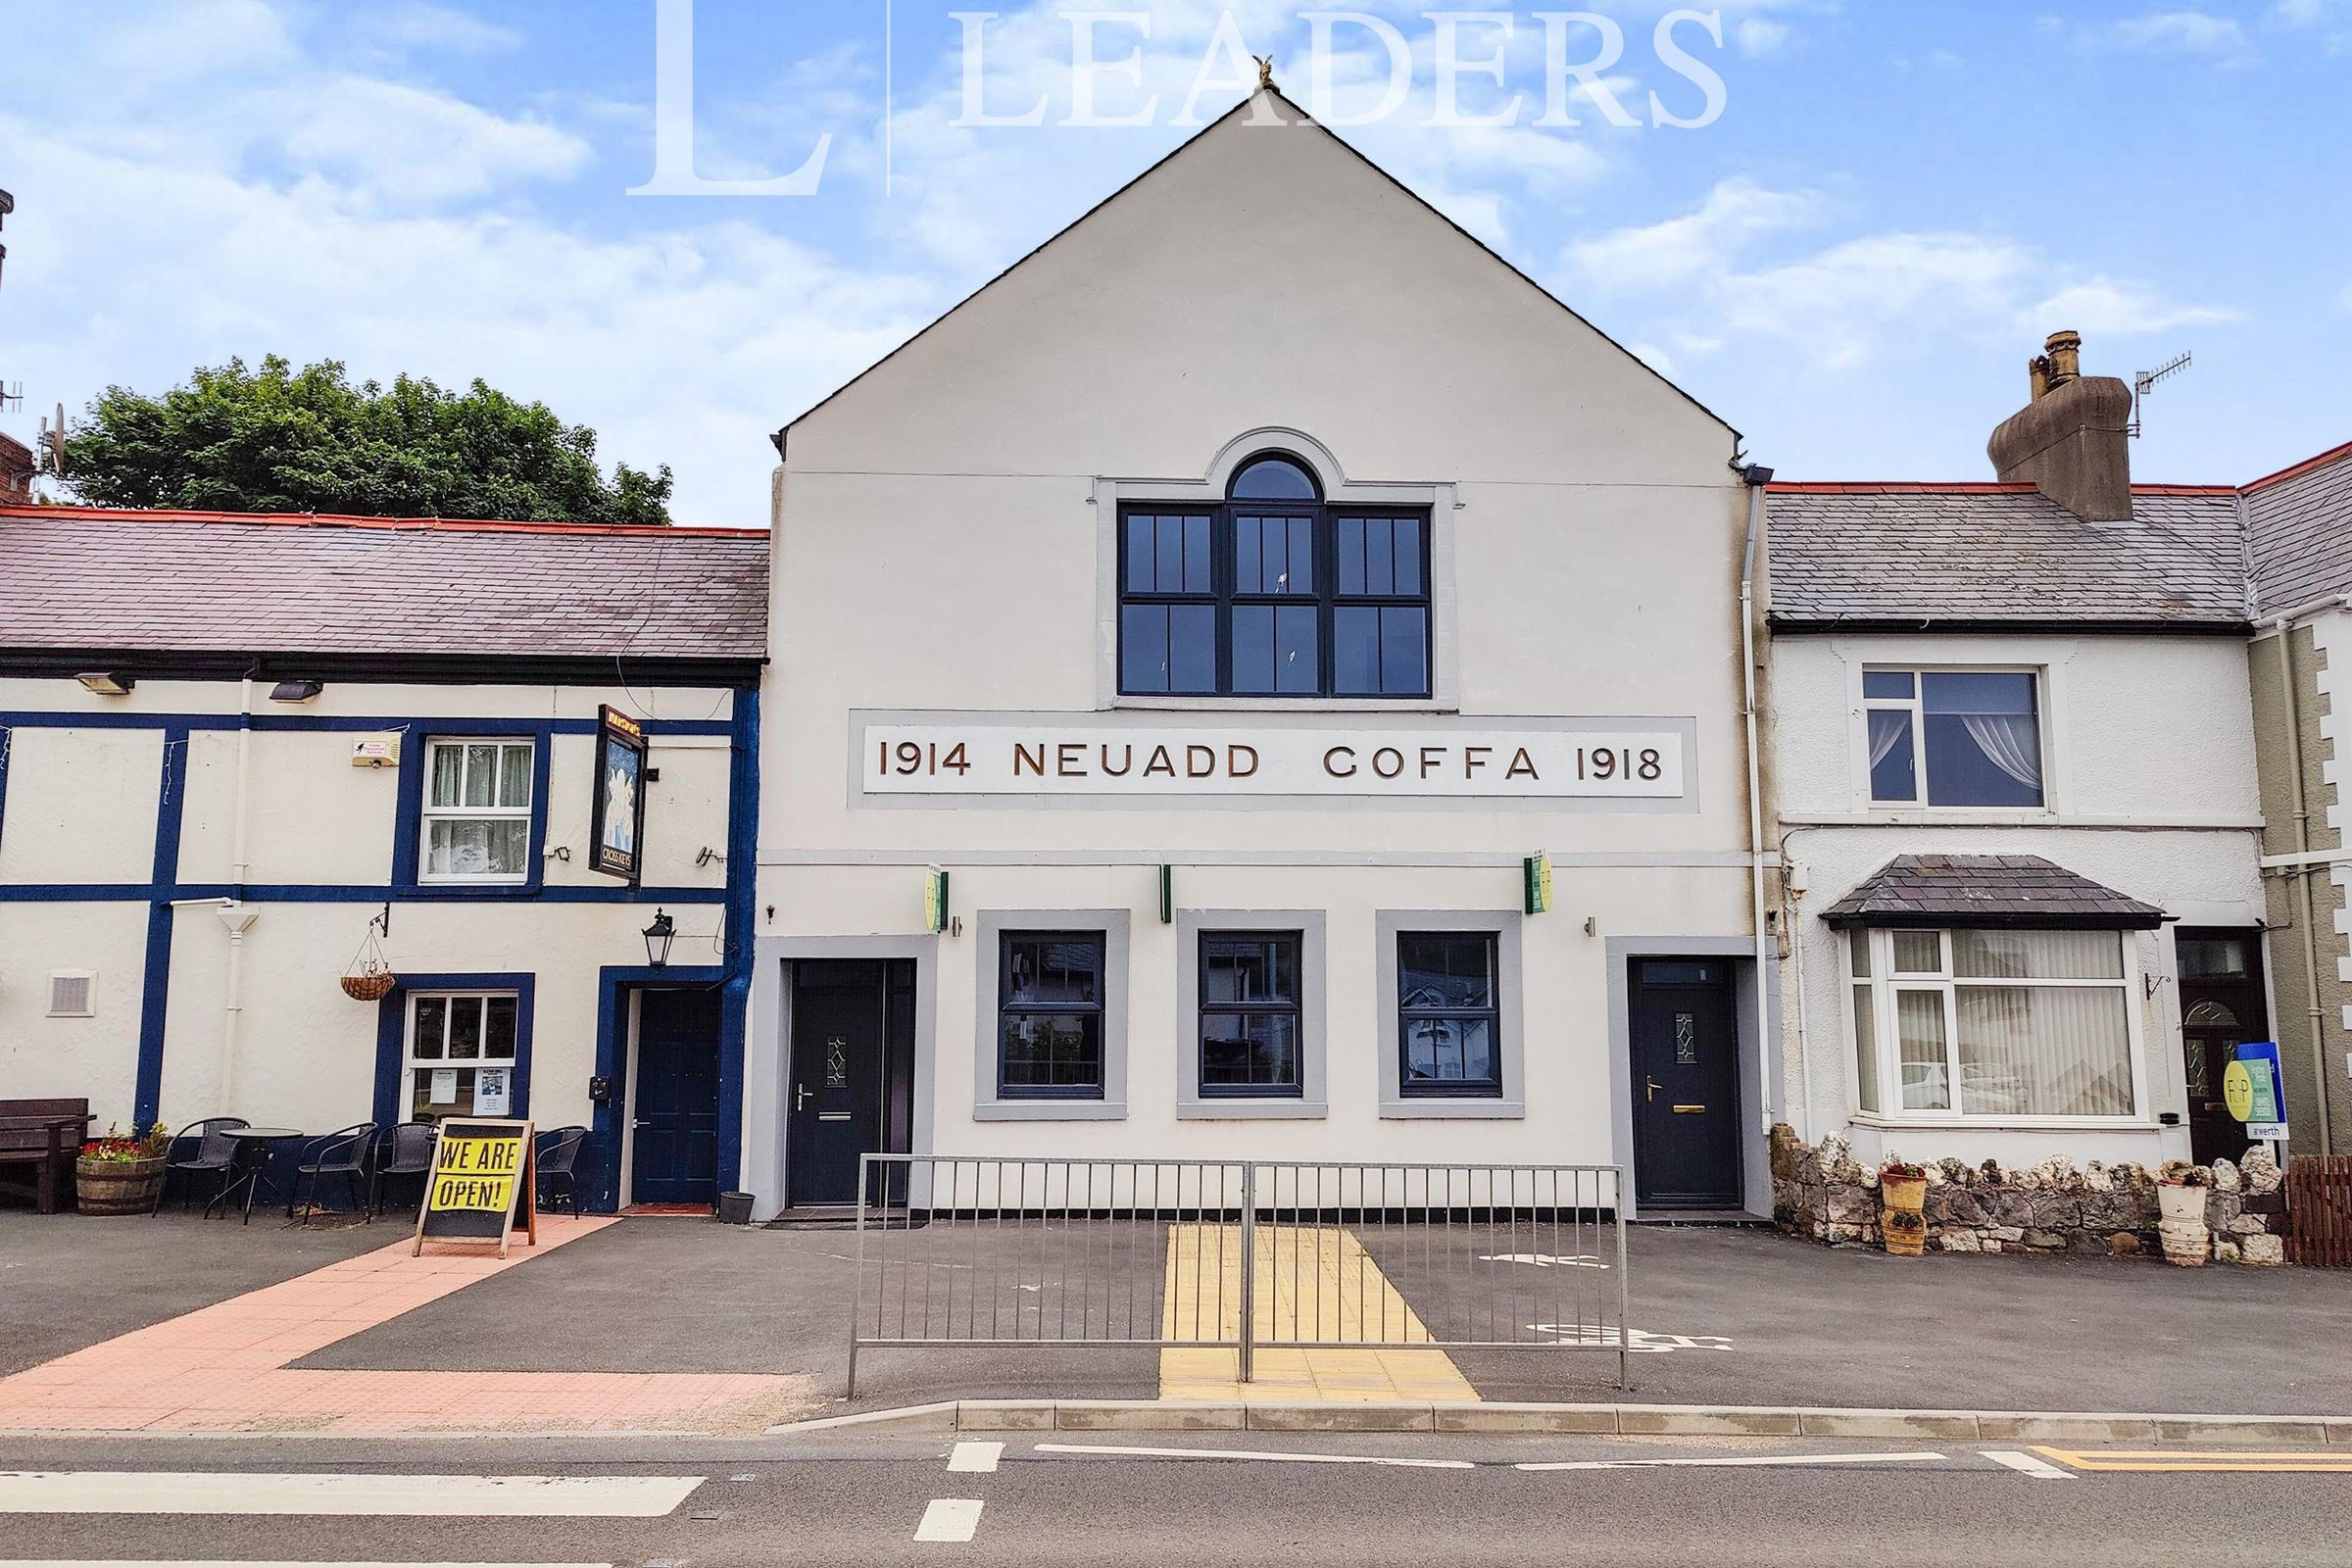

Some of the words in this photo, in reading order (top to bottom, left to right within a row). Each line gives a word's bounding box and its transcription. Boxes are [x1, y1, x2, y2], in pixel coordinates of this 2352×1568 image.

[878, 742, 972, 776] 1914
[1013, 744, 1260, 778] NEUADD
[1577, 748, 1663, 781] 1918
[439, 1142, 471, 1168] WE
[476, 1142, 517, 1169] ARE
[438, 1180, 502, 1207] OPEN!
